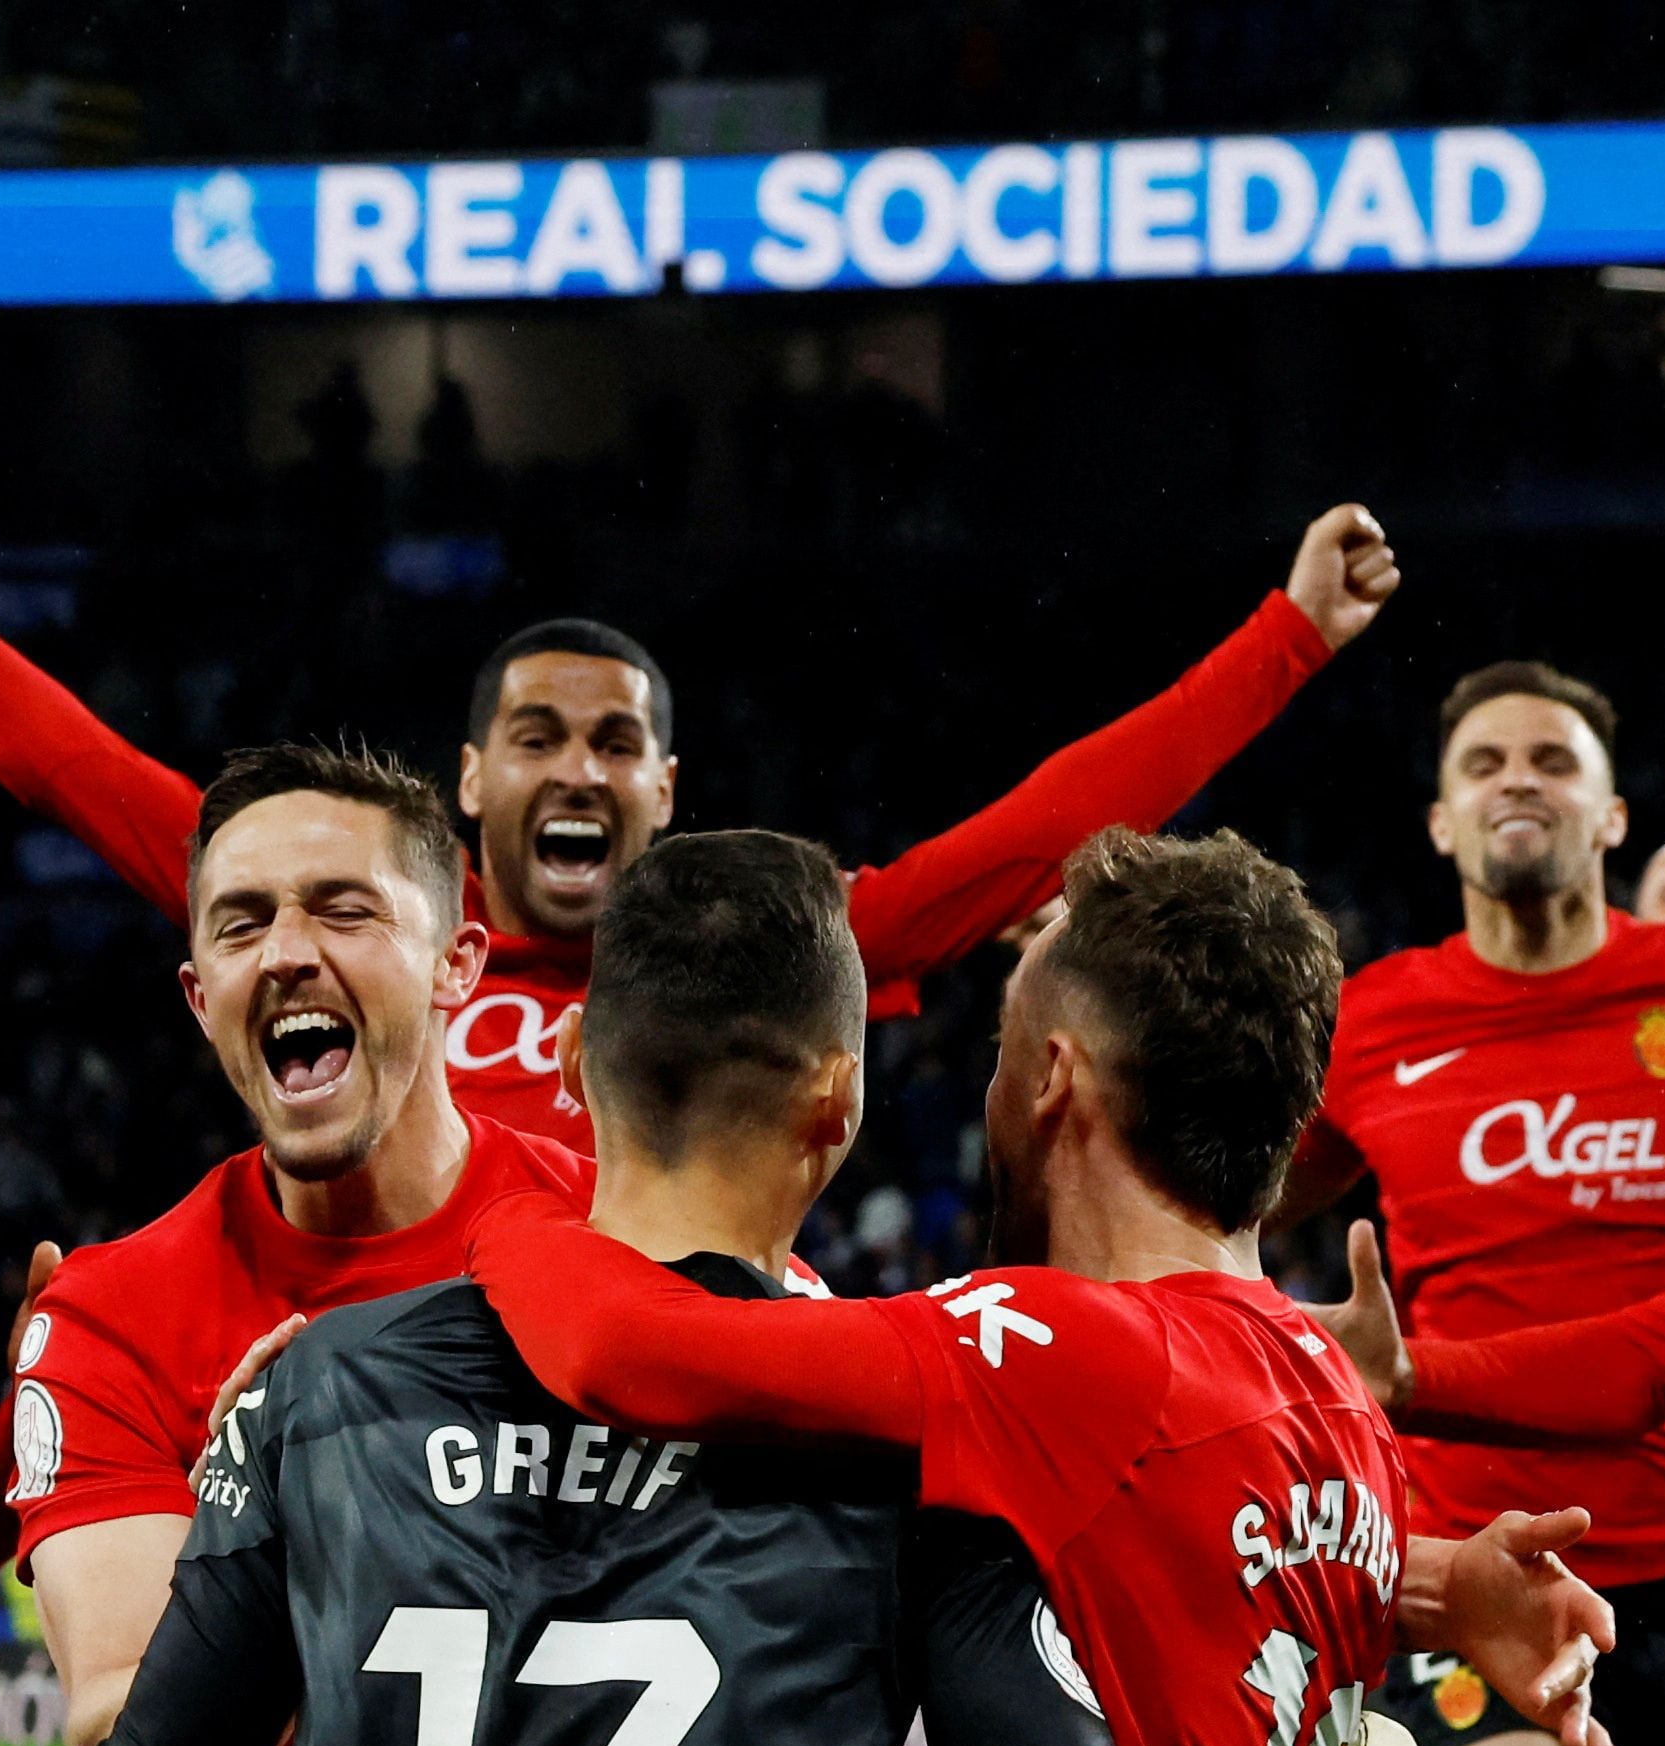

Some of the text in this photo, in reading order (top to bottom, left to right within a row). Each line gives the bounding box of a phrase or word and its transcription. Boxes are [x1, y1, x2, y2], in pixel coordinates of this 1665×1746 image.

[316, 129, 1544, 295] REAL SOCIEDAD
[425, 1421, 701, 1511] GREIF
